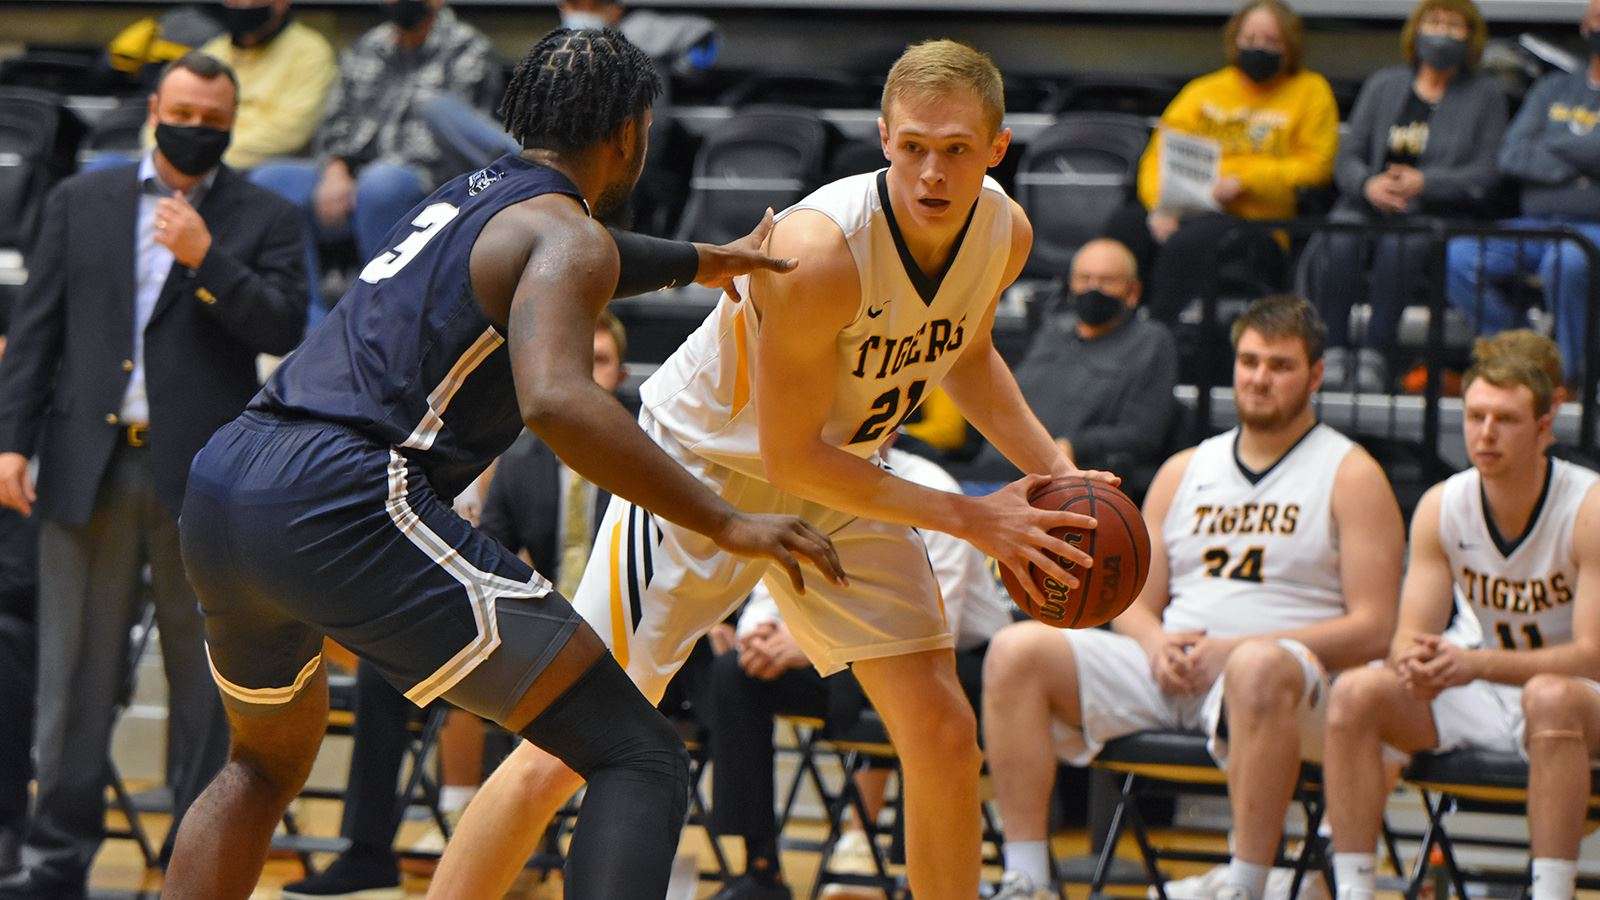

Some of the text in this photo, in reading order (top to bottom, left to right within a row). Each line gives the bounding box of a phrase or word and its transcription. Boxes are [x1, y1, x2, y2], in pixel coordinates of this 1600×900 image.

[358, 202, 460, 285] 3
[851, 313, 967, 379] TIGERS
[847, 380, 928, 446] 21
[1193, 503, 1299, 535] TIGERS
[1040, 532, 1084, 622] Wilon
[1463, 567, 1573, 613] TIGERS
[1495, 621, 1544, 650] 11
